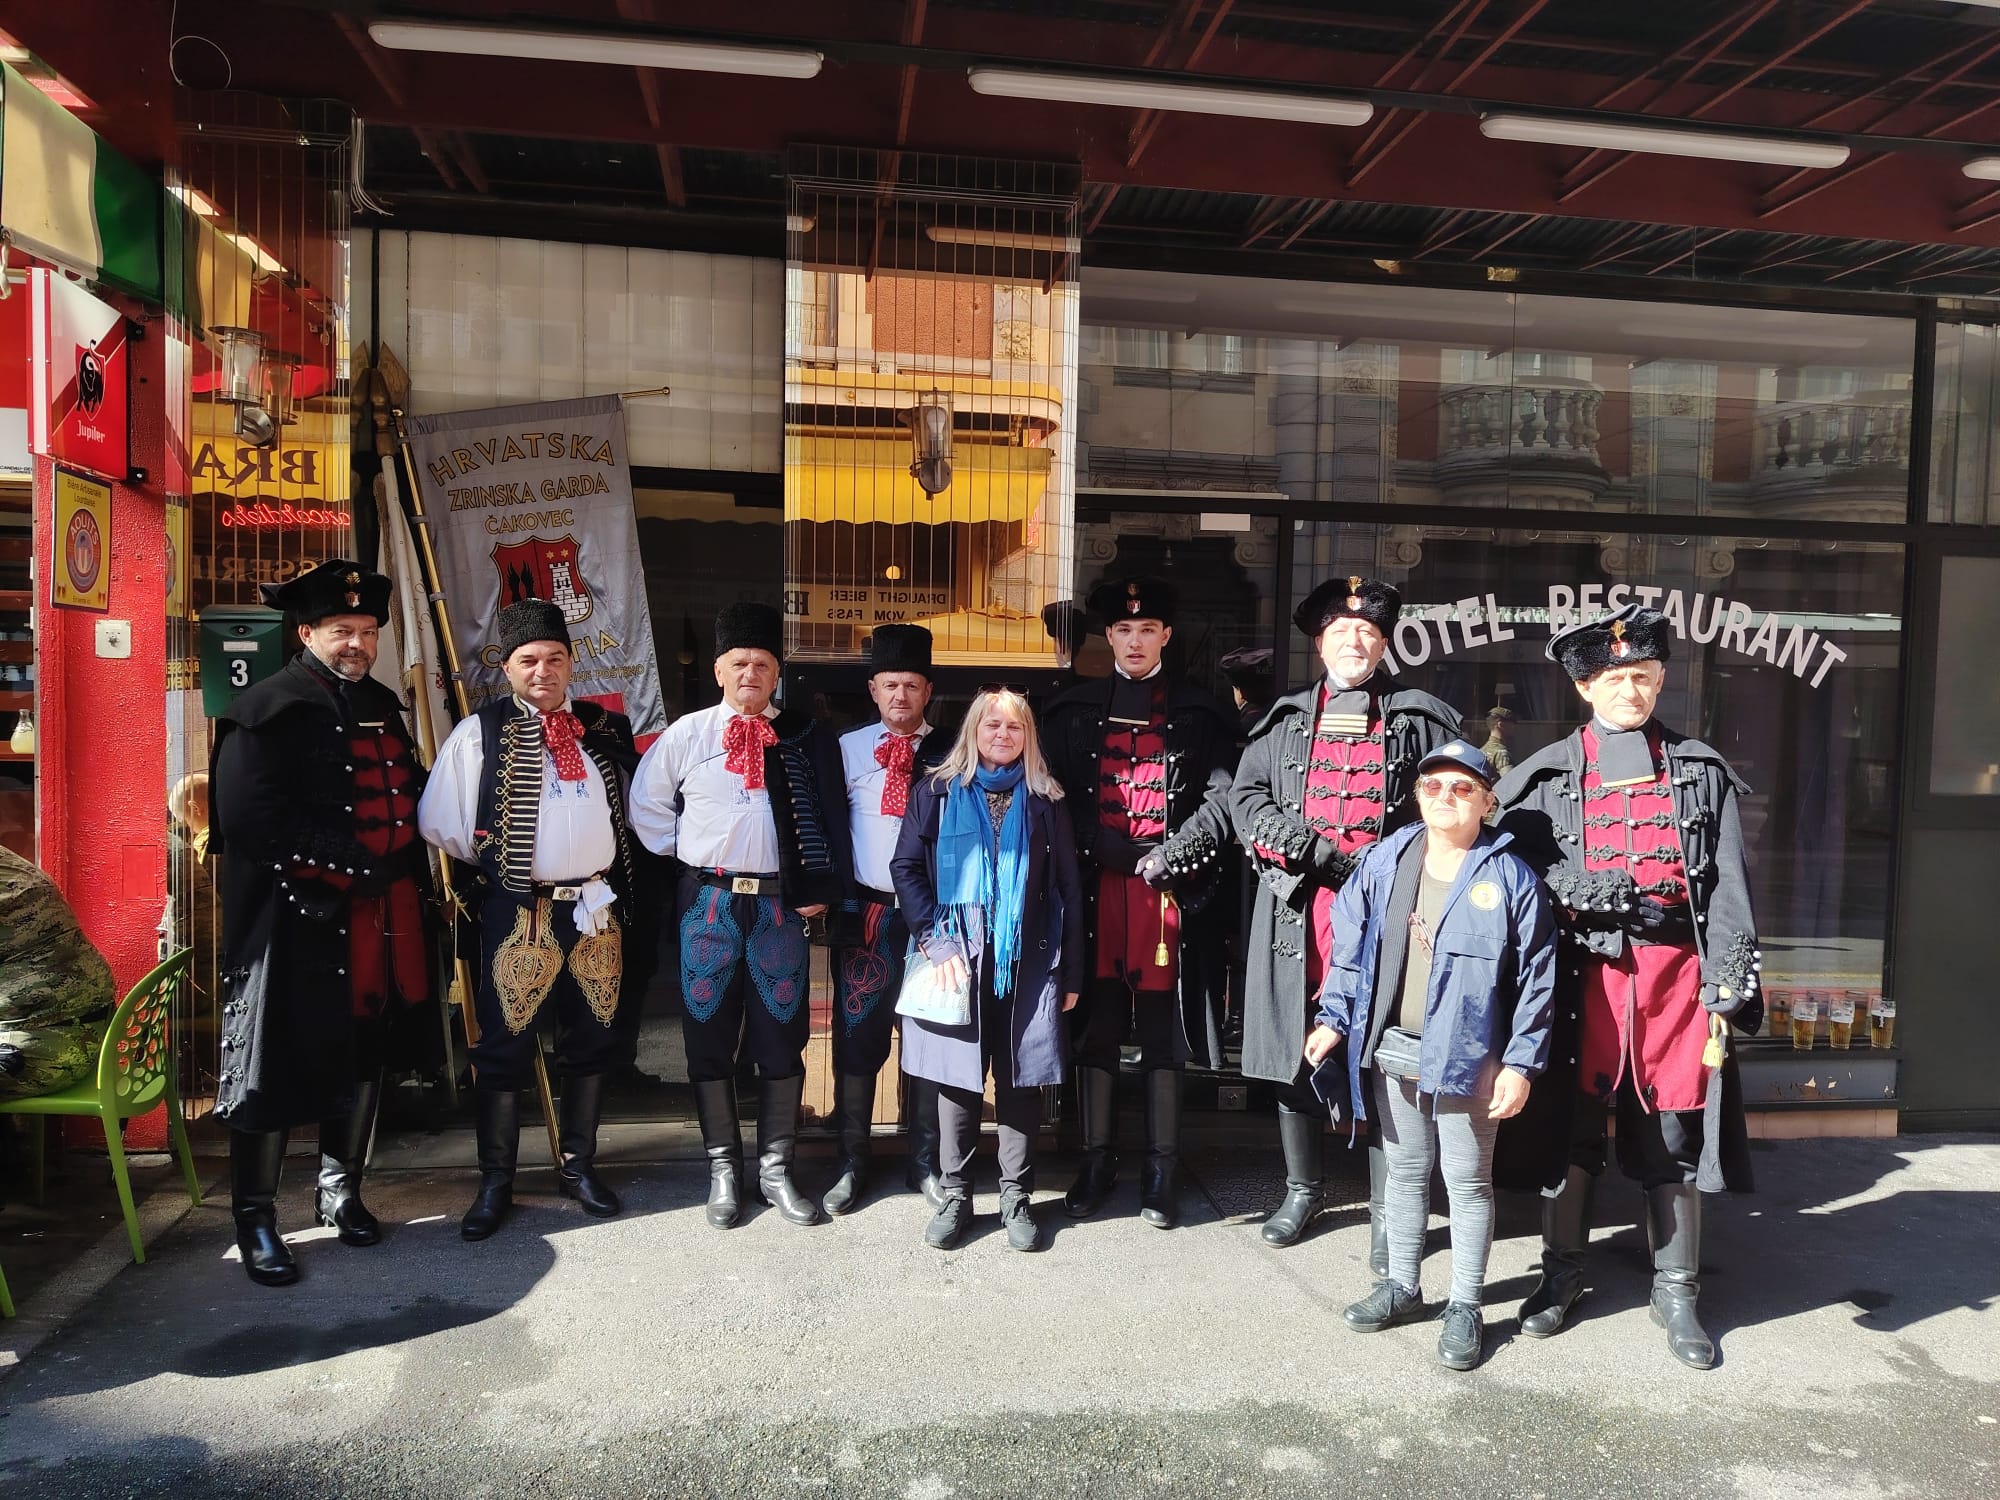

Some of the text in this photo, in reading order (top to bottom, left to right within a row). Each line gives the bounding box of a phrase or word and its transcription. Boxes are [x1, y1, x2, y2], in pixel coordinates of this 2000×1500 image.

[76, 420, 106, 444] Jupiler
[428, 432, 615, 487] HRVATSKA
[448, 472, 609, 511] ZRINSKA GARDA
[485, 509, 575, 534] ČAKOVEC
[231, 659, 249, 687] 3
